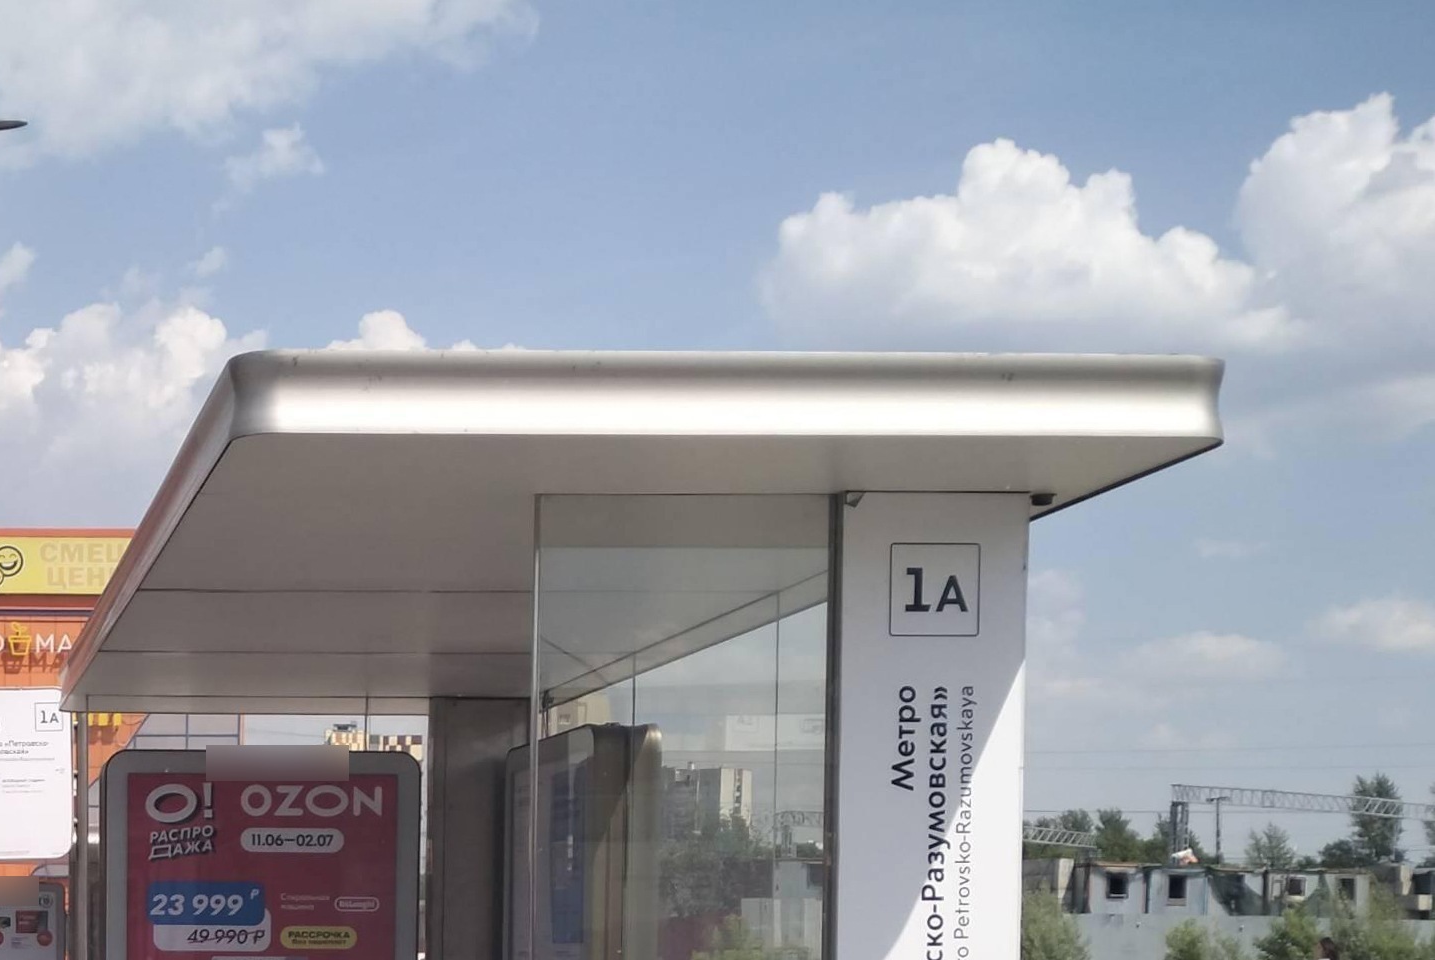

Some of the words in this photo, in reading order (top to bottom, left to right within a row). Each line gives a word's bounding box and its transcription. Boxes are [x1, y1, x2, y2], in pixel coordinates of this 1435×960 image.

[47, 567, 110, 589] ЦЕН
[891, 685, 922, 791] Метро
[240, 784, 383, 816] OZON
[954, 685, 977, 939] Petrovsko-Razumovskaya
[150, 824, 214, 845] РАСПРО
[148, 839, 213, 861] ДАЖА
[288, 931, 350, 939] РАССРОЧКА
